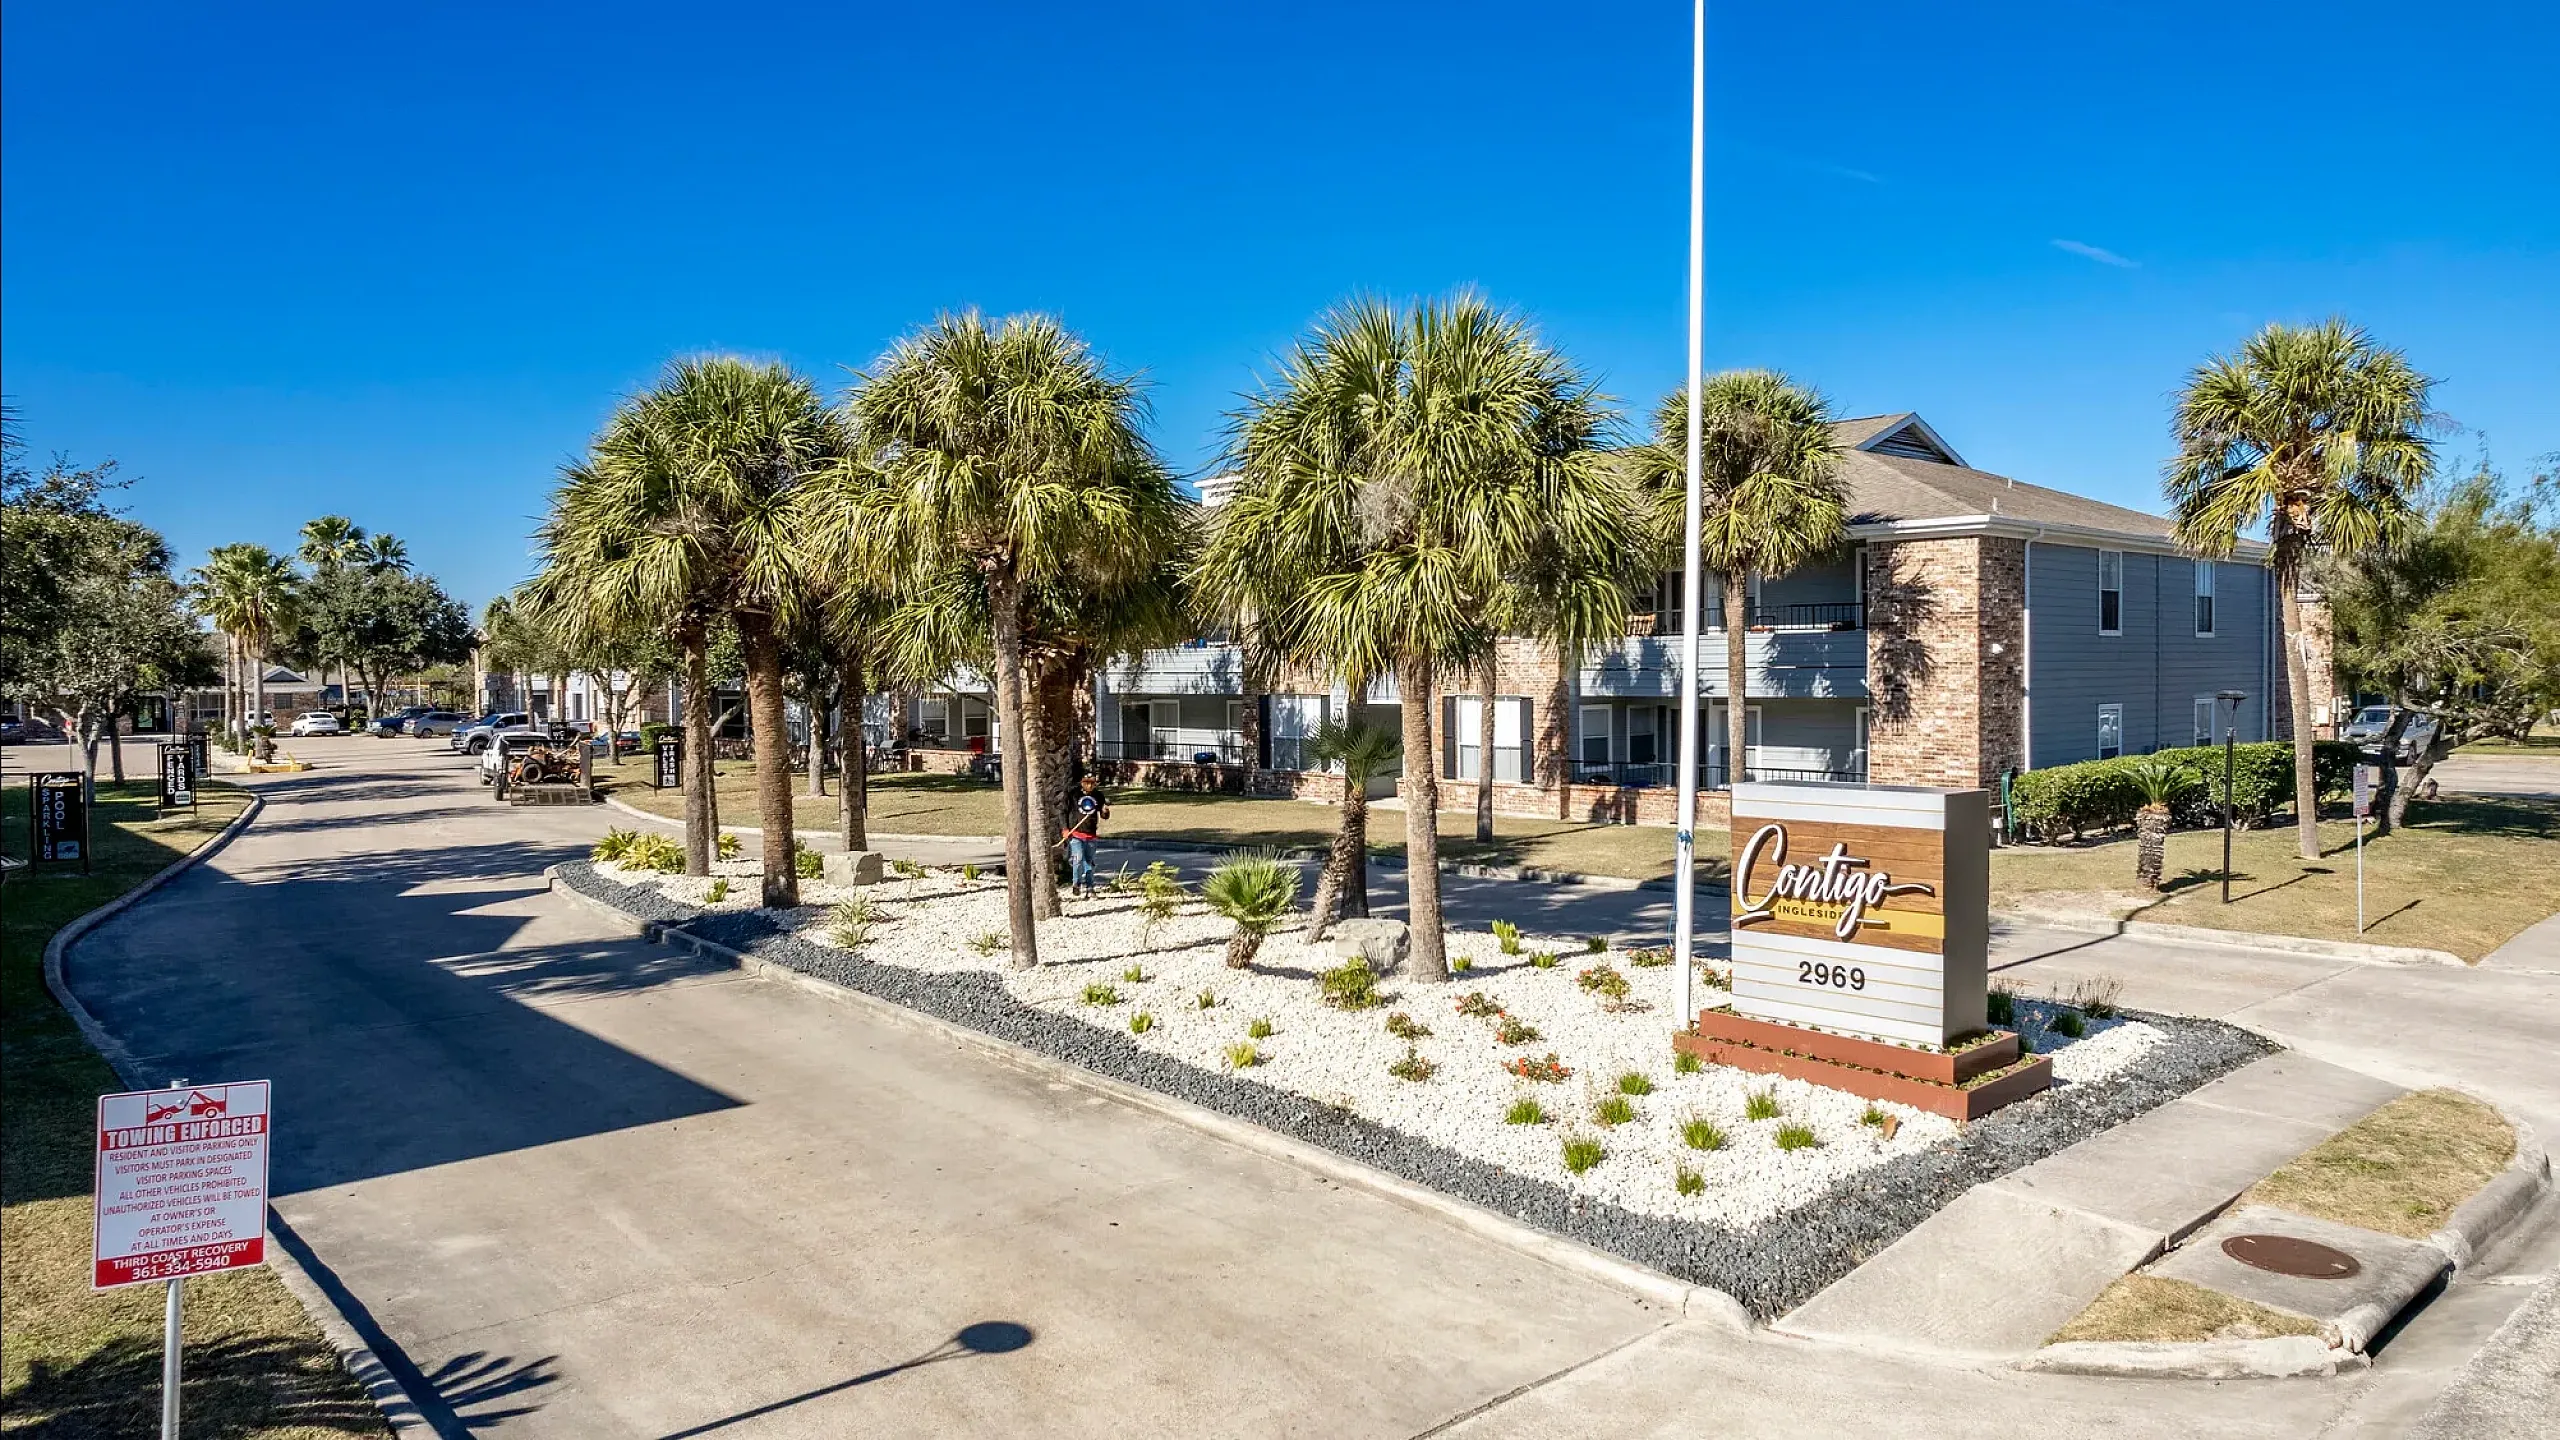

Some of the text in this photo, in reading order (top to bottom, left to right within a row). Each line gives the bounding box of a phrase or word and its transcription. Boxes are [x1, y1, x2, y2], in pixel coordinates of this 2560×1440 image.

[166, 755, 175, 795] FENCED
[177, 755, 186, 790] YARDS
[42, 788, 52, 860] SPARKLING
[55, 791, 65, 830] POOL
[1734, 823, 1935, 940] Contigo
[1799, 961, 1866, 991] 2969
[107, 1117, 262, 1148] TOWING ENFORCED
[109, 1138, 258, 1161] RESIDENT AND VISITOR PARKING ONLY
[115, 1151, 252, 1175] VISITORS MUST PARK IN DESIGNATED
[119, 1177, 247, 1200] ALL OTHER VEHICLES PROHIBITED
[136, 1165, 232, 1185] VISITOR PARKING SPACES
[103, 1188, 260, 1216] UNAUTHORIZED VEHICLES WILL BE TOWED
[151, 1207, 215, 1222] AT OWNER'S OR
[131, 1229, 233, 1252] AT ALL TIMES AND DAYS
[138, 1218, 226, 1237] OPERATOR'S EXPENSE
[113, 1242, 249, 1269] THIRD COAST RECOVERY
